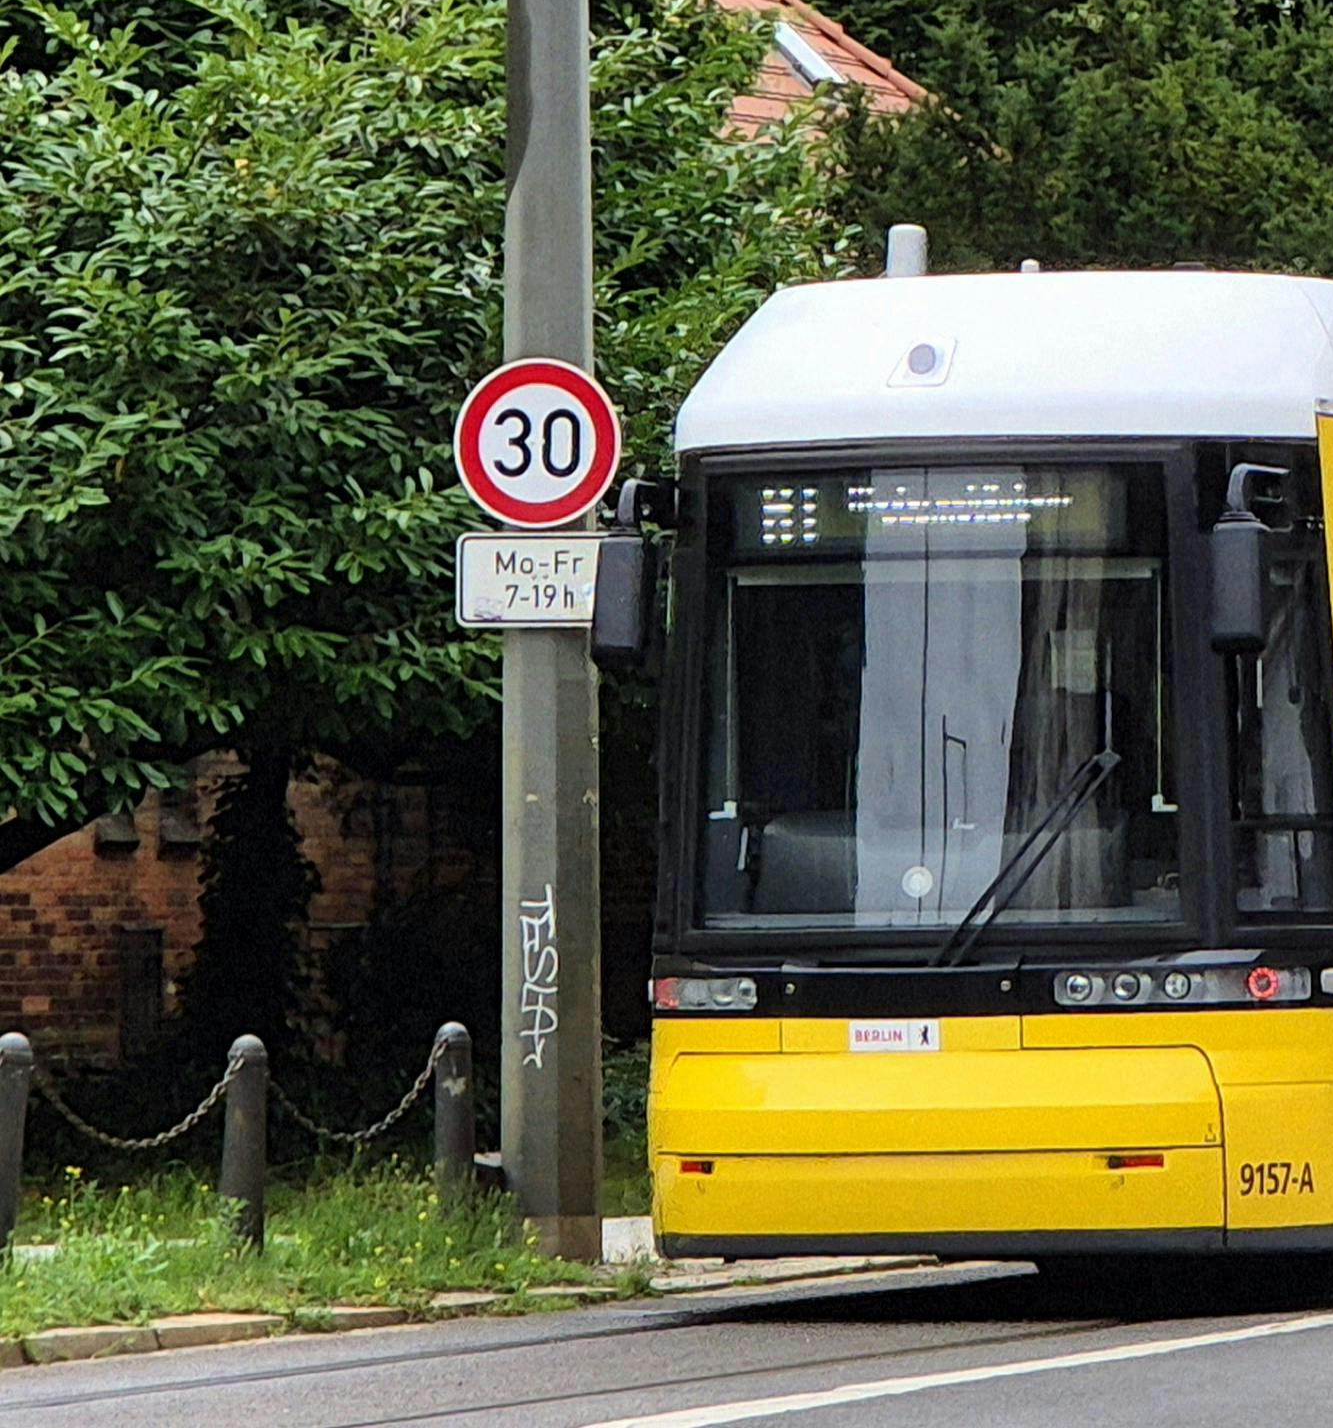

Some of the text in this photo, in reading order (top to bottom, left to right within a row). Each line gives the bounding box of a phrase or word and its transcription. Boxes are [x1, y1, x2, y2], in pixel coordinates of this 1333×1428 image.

[494, 408, 580, 478] 30
[495, 550, 583, 575] Mo-Fr
[505, 584, 575, 609] 7-19 h
[855, 1029, 903, 1042] BERLIN
[1240, 1162, 1314, 1196] 9157-A
